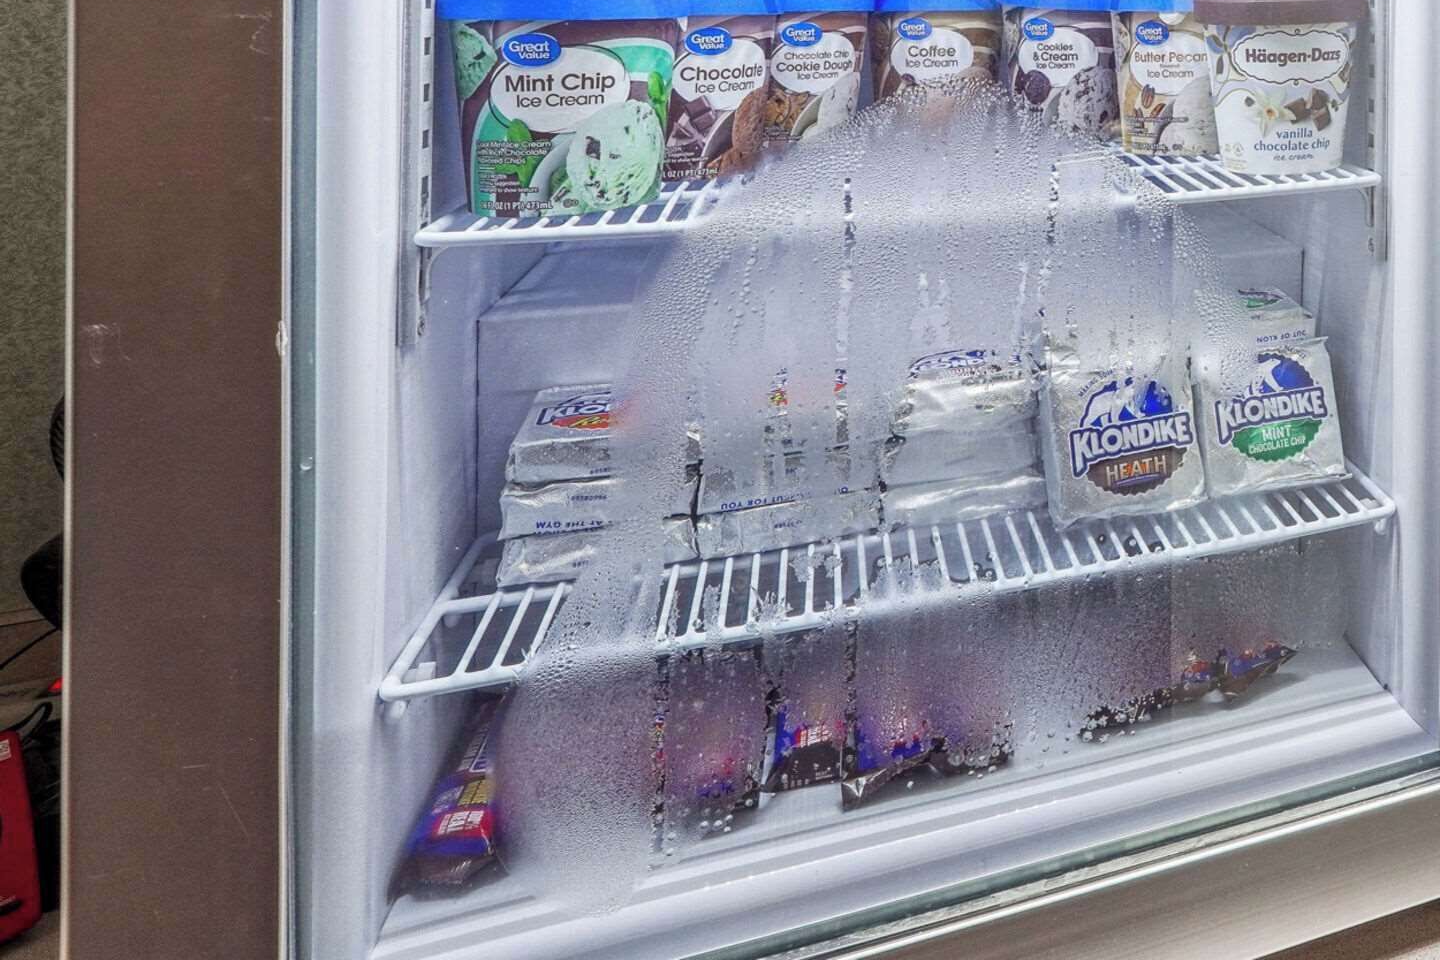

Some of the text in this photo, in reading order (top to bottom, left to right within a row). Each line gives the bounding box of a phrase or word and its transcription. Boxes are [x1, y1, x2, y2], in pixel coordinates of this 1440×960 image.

[785, 28, 815, 38] Great
[1138, 25, 1163, 35] Great
[691, 33, 725, 44] Great
[508, 40, 550, 54] Great
[908, 46, 956, 58] Coffee
[1036, 43, 1074, 52] Cookies
[518, 50, 550, 60] Value
[784, 50, 850, 61] Chocolate Chip
[1033, 51, 1079, 61] & Cream
[1134, 51, 1208, 63] Butter Pecan
[776, 60, 853, 73] Cookie Dough
[905, 58, 959, 68] Ice Cream
[680, 64, 763, 82] Chocolate
[797, 70, 839, 80] Ice Cream
[1147, 69, 1194, 79] Ice Cream
[505, 72, 615, 95] Mint Chip
[695, 80, 755, 94] Ice Cream
[516, 93, 605, 108] Ice Cream
[1276, 128, 1313, 140] vanilla
[1253, 138, 1331, 153] chocolate chip
[1217, 389, 1326, 443] KLONDIKE
[1262, 425, 1292, 438] MINT
[1072, 414, 1191, 474] KLONDIKE
[1249, 437, 1290, 454] CHOCOLATE
[1104, 455, 1167, 480] HEATH
